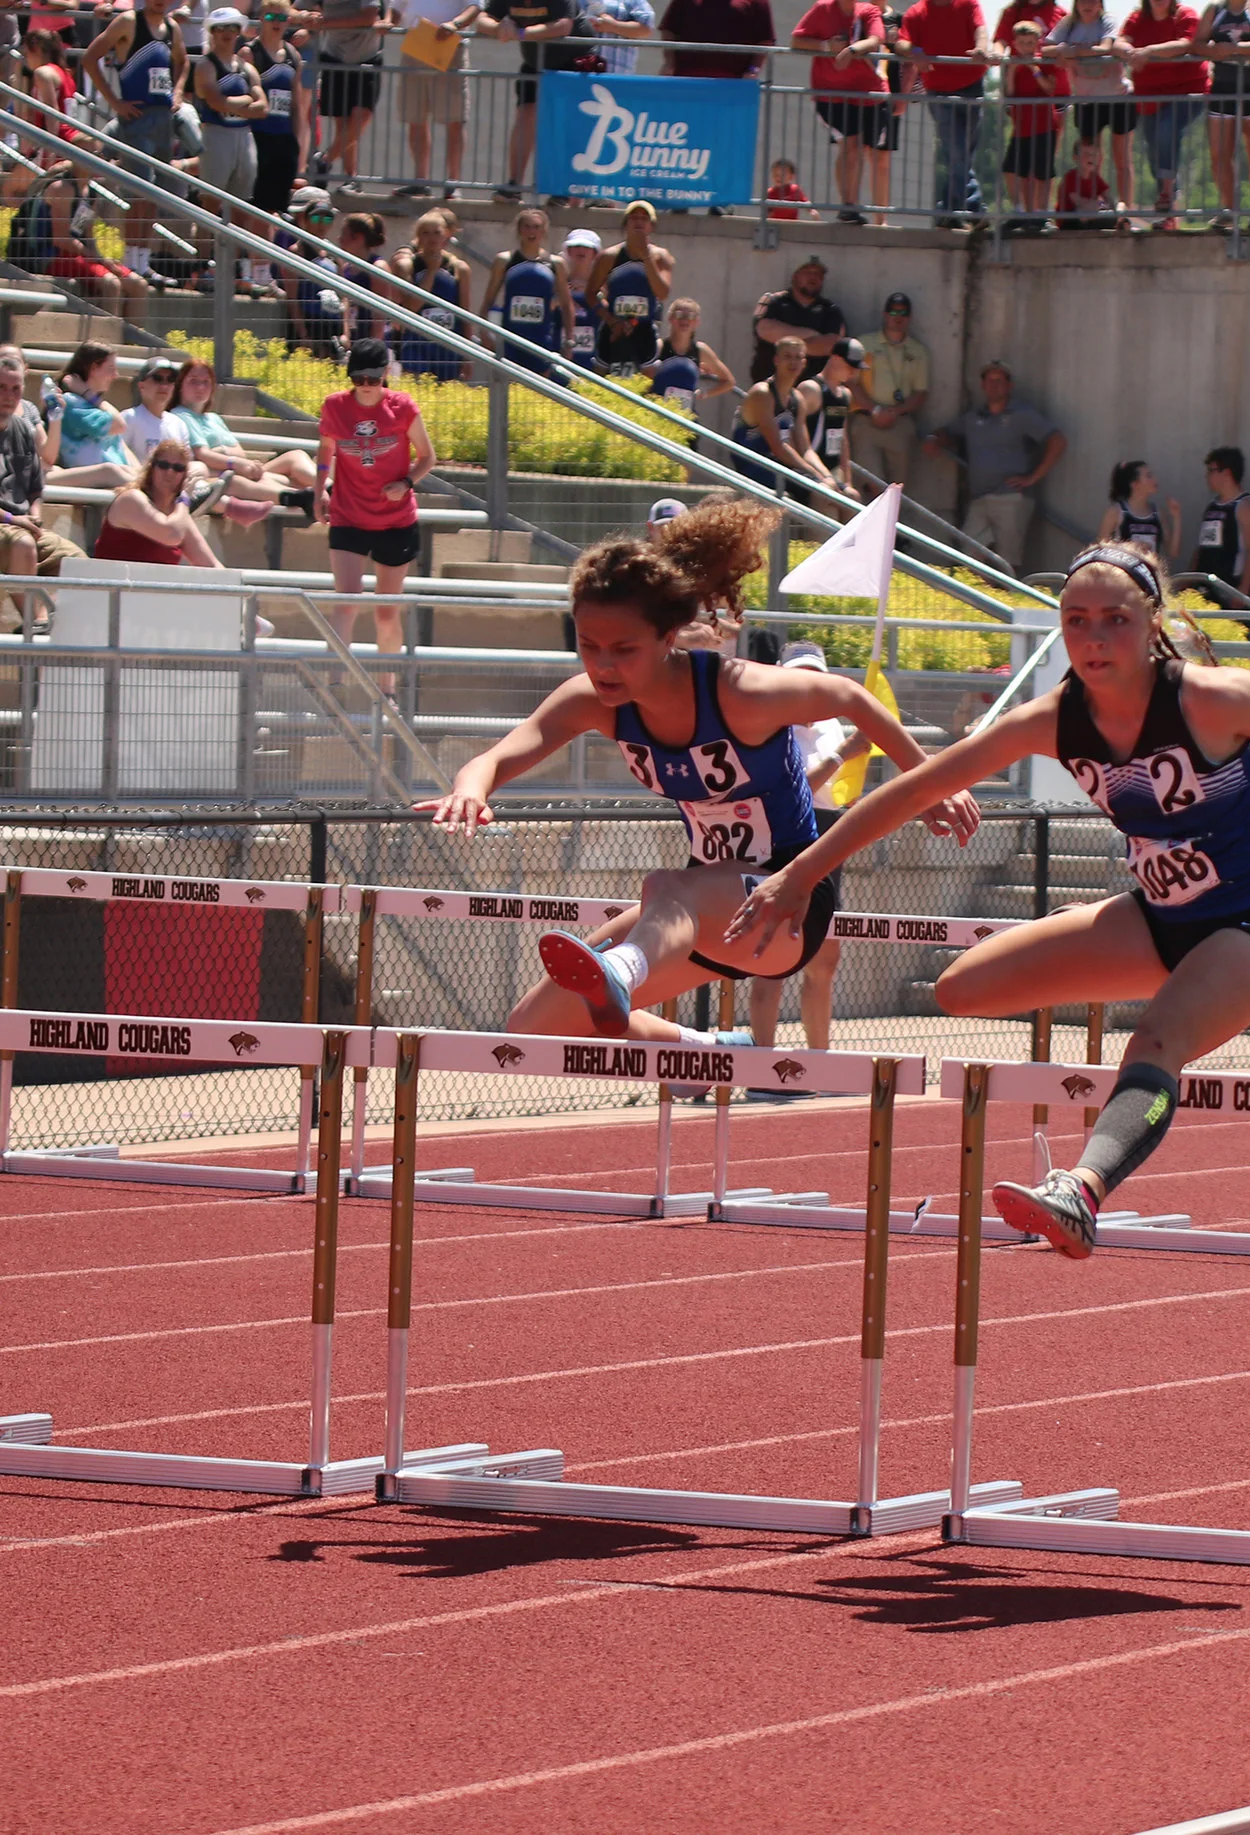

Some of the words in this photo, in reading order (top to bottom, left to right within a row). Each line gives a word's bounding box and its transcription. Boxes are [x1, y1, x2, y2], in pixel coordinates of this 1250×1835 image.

[629, 168, 646, 178] ICE
[649, 169, 686, 179] CREAM
[568, 184, 599, 196] GIVE
[601, 186, 615, 197] IN
[617, 187, 634, 198] TO
[638, 187, 663, 199] THE
[666, 189, 711, 201] BUNNY
[626, 743, 653, 788] 3
[700, 741, 737, 792] 3
[1150, 753, 1196, 812] 2
[697, 820, 757, 862] 882
[112, 878, 165, 898] HIGHLAND
[171, 881, 220, 902] COUGARS
[1130, 847, 1208, 900] 1048
[469, 897, 523, 919] HIGHLAND
[529, 900, 579, 921] COUGARS
[834, 917, 890, 938] HIGHLAND
[896, 920, 948, 941] COUGARS
[29, 1018, 109, 1051] HIGHLAND
[118, 1023, 192, 1055] COUGARS
[563, 1044, 647, 1077] HIGHLAND
[656, 1049, 734, 1082] COUGARS
